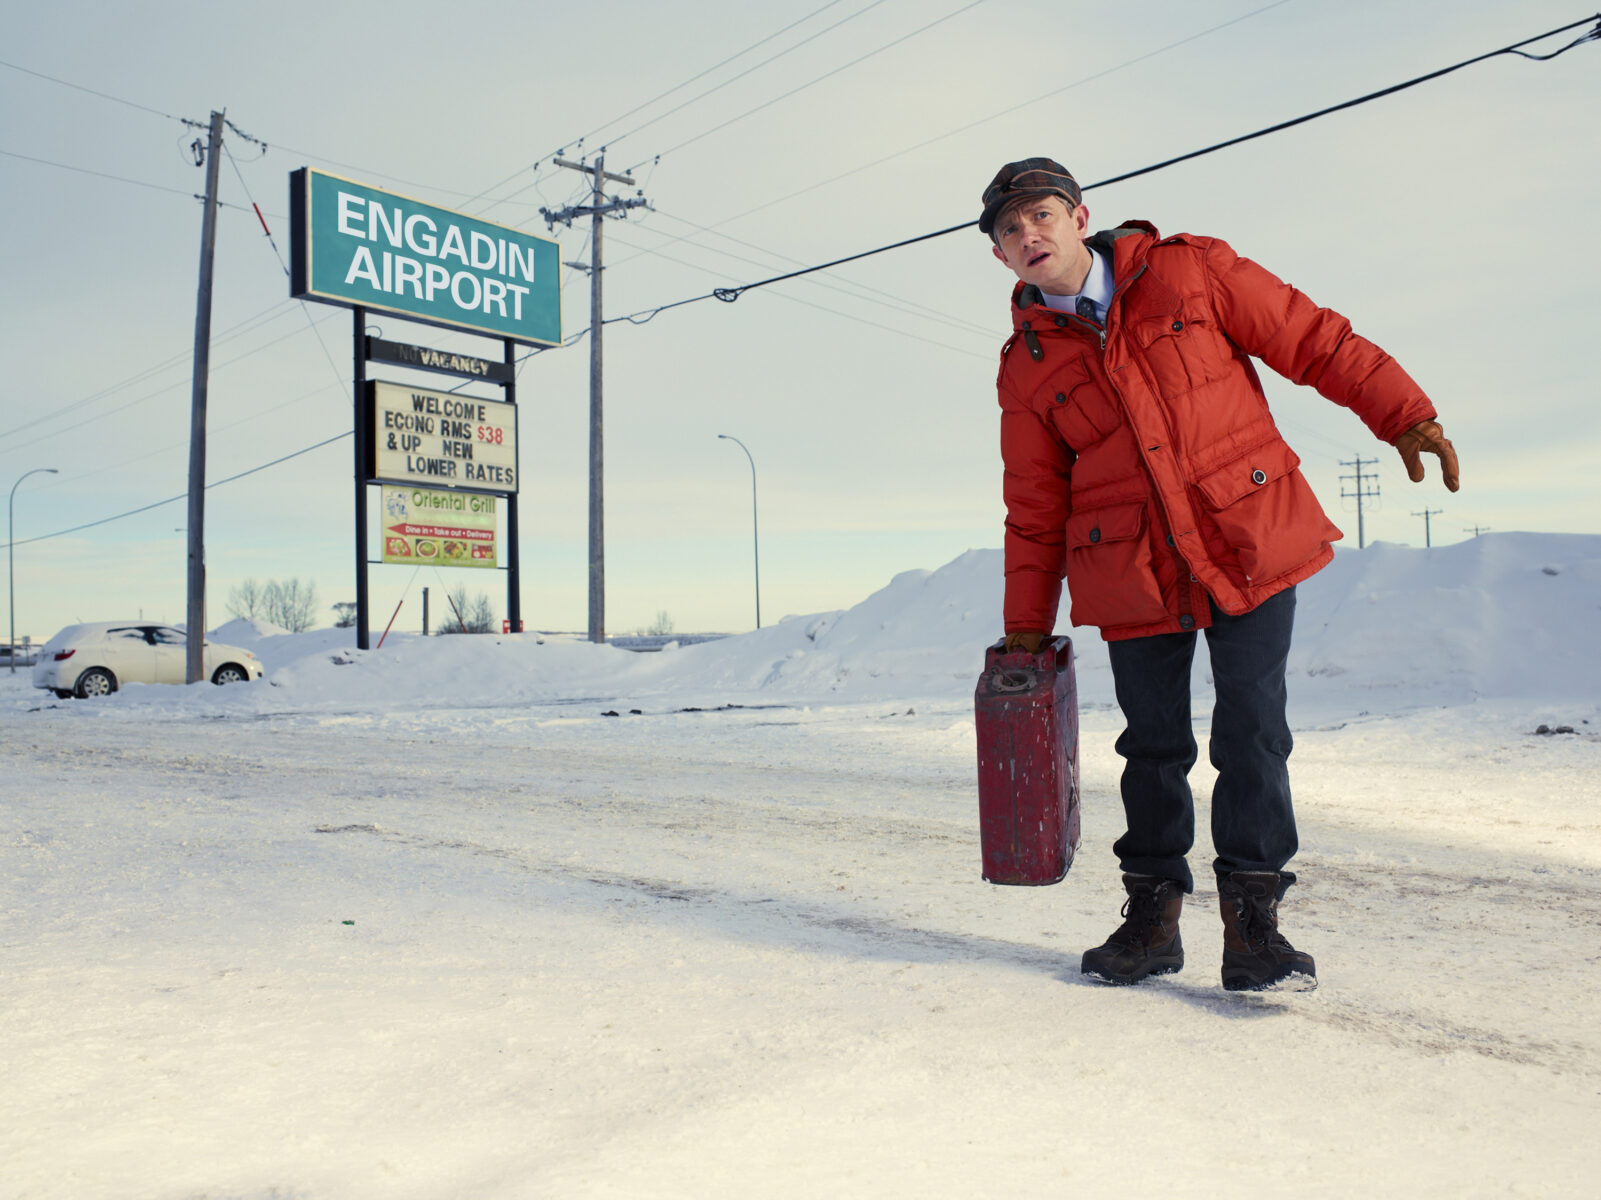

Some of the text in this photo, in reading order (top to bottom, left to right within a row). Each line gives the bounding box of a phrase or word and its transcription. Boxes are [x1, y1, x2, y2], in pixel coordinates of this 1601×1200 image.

[338, 191, 534, 282] ENGADIN
[344, 246, 529, 320] AIRPORT
[420, 350, 489, 375] VACANCY
[412, 394, 486, 421] WELCOME
[385, 411, 503, 444] ECONO RMS $38
[387, 432, 473, 459] & UP NEW
[407, 455, 514, 483] LOWER RATES
[412, 490, 495, 513] Oriental Grill
[405, 525, 492, 539] Dine in Take out Delivery
